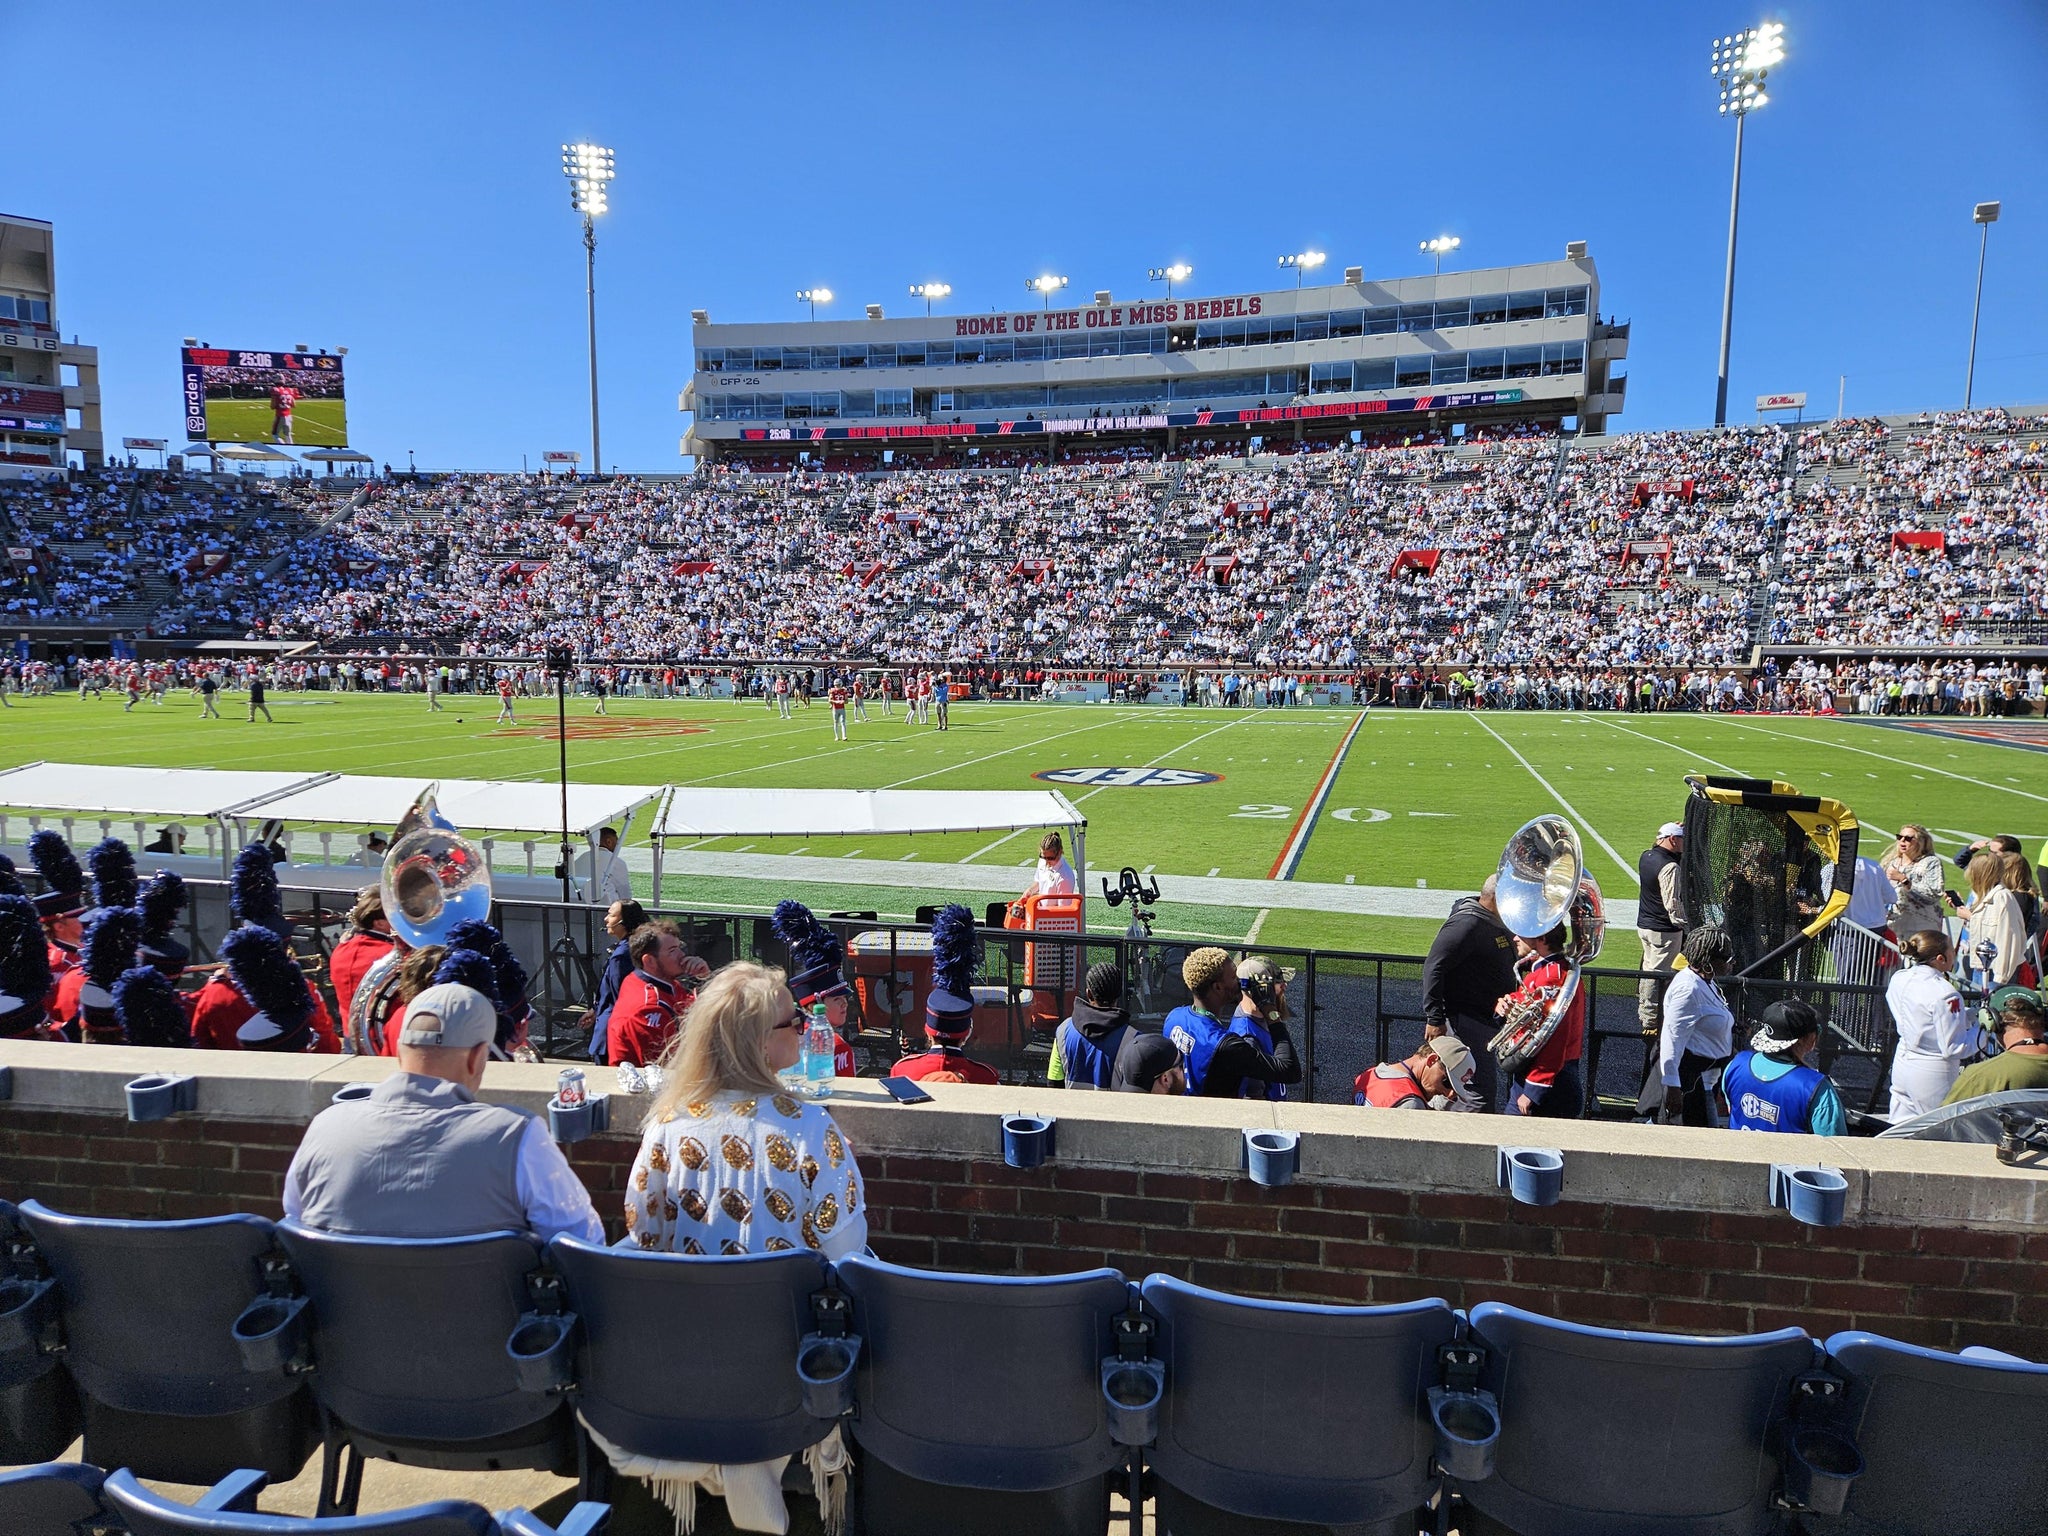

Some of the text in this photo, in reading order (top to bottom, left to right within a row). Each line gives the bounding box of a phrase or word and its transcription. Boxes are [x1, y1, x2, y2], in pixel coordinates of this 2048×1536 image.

[956, 296, 1262, 336] HOME OF THE OLE MISS REBELS
[33, 337, 57, 350] 18
[239, 352, 272, 367] 25:06
[303, 357, 315, 368] VS
[720, 378, 741, 386] CFP
[185, 373, 199, 416] arden
[1239, 410, 1258, 421] NEXT
[1260, 408, 1283, 420] HOME
[1285, 407, 1299, 419] OLE
[1301, 405, 1321, 417] MISS
[1323, 403, 1356, 415] SOCCER
[1358, 400, 1388, 413] MATCH
[769, 428, 791, 439] 25:06
[848, 427, 865, 438] NEXT
[867, 426, 887, 437] HOME
[889, 426, 900, 436] OLE
[902, 425, 920, 436] MISS
[922, 424, 950, 435] SOCCER
[951, 423, 976, 434] MATCH
[1042, 418, 1085, 432] TOMORROW
[1086, 418, 1095, 430] AT
[1097, 417, 1113, 429] 3PM
[1115, 417, 1126, 429] VS
[1127, 415, 1168, 428] OKLAHOMA
[874, 970, 914, 1014] G
[1742, 1094, 1760, 1117] SEC
